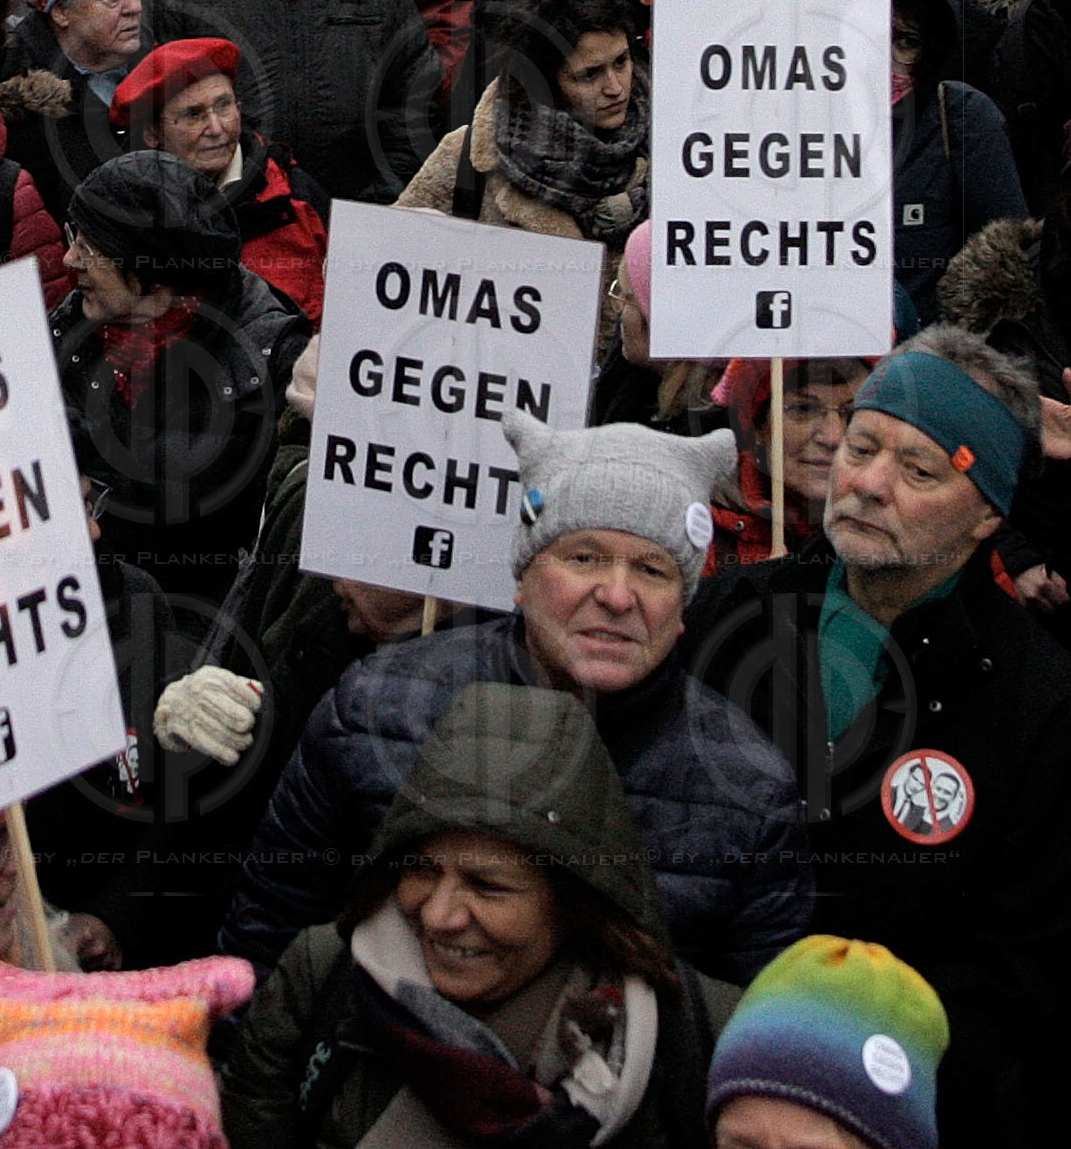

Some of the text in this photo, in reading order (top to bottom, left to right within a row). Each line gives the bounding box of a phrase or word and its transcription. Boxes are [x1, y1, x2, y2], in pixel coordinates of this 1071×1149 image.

[701, 45, 846, 91] OMAS
[682, 132, 860, 178] GEGEN
[667, 221, 876, 266] RECHTS
[376, 262, 542, 334] OMAS
[349, 349, 551, 424] GEGEN
[324, 433, 520, 516] RECHT
